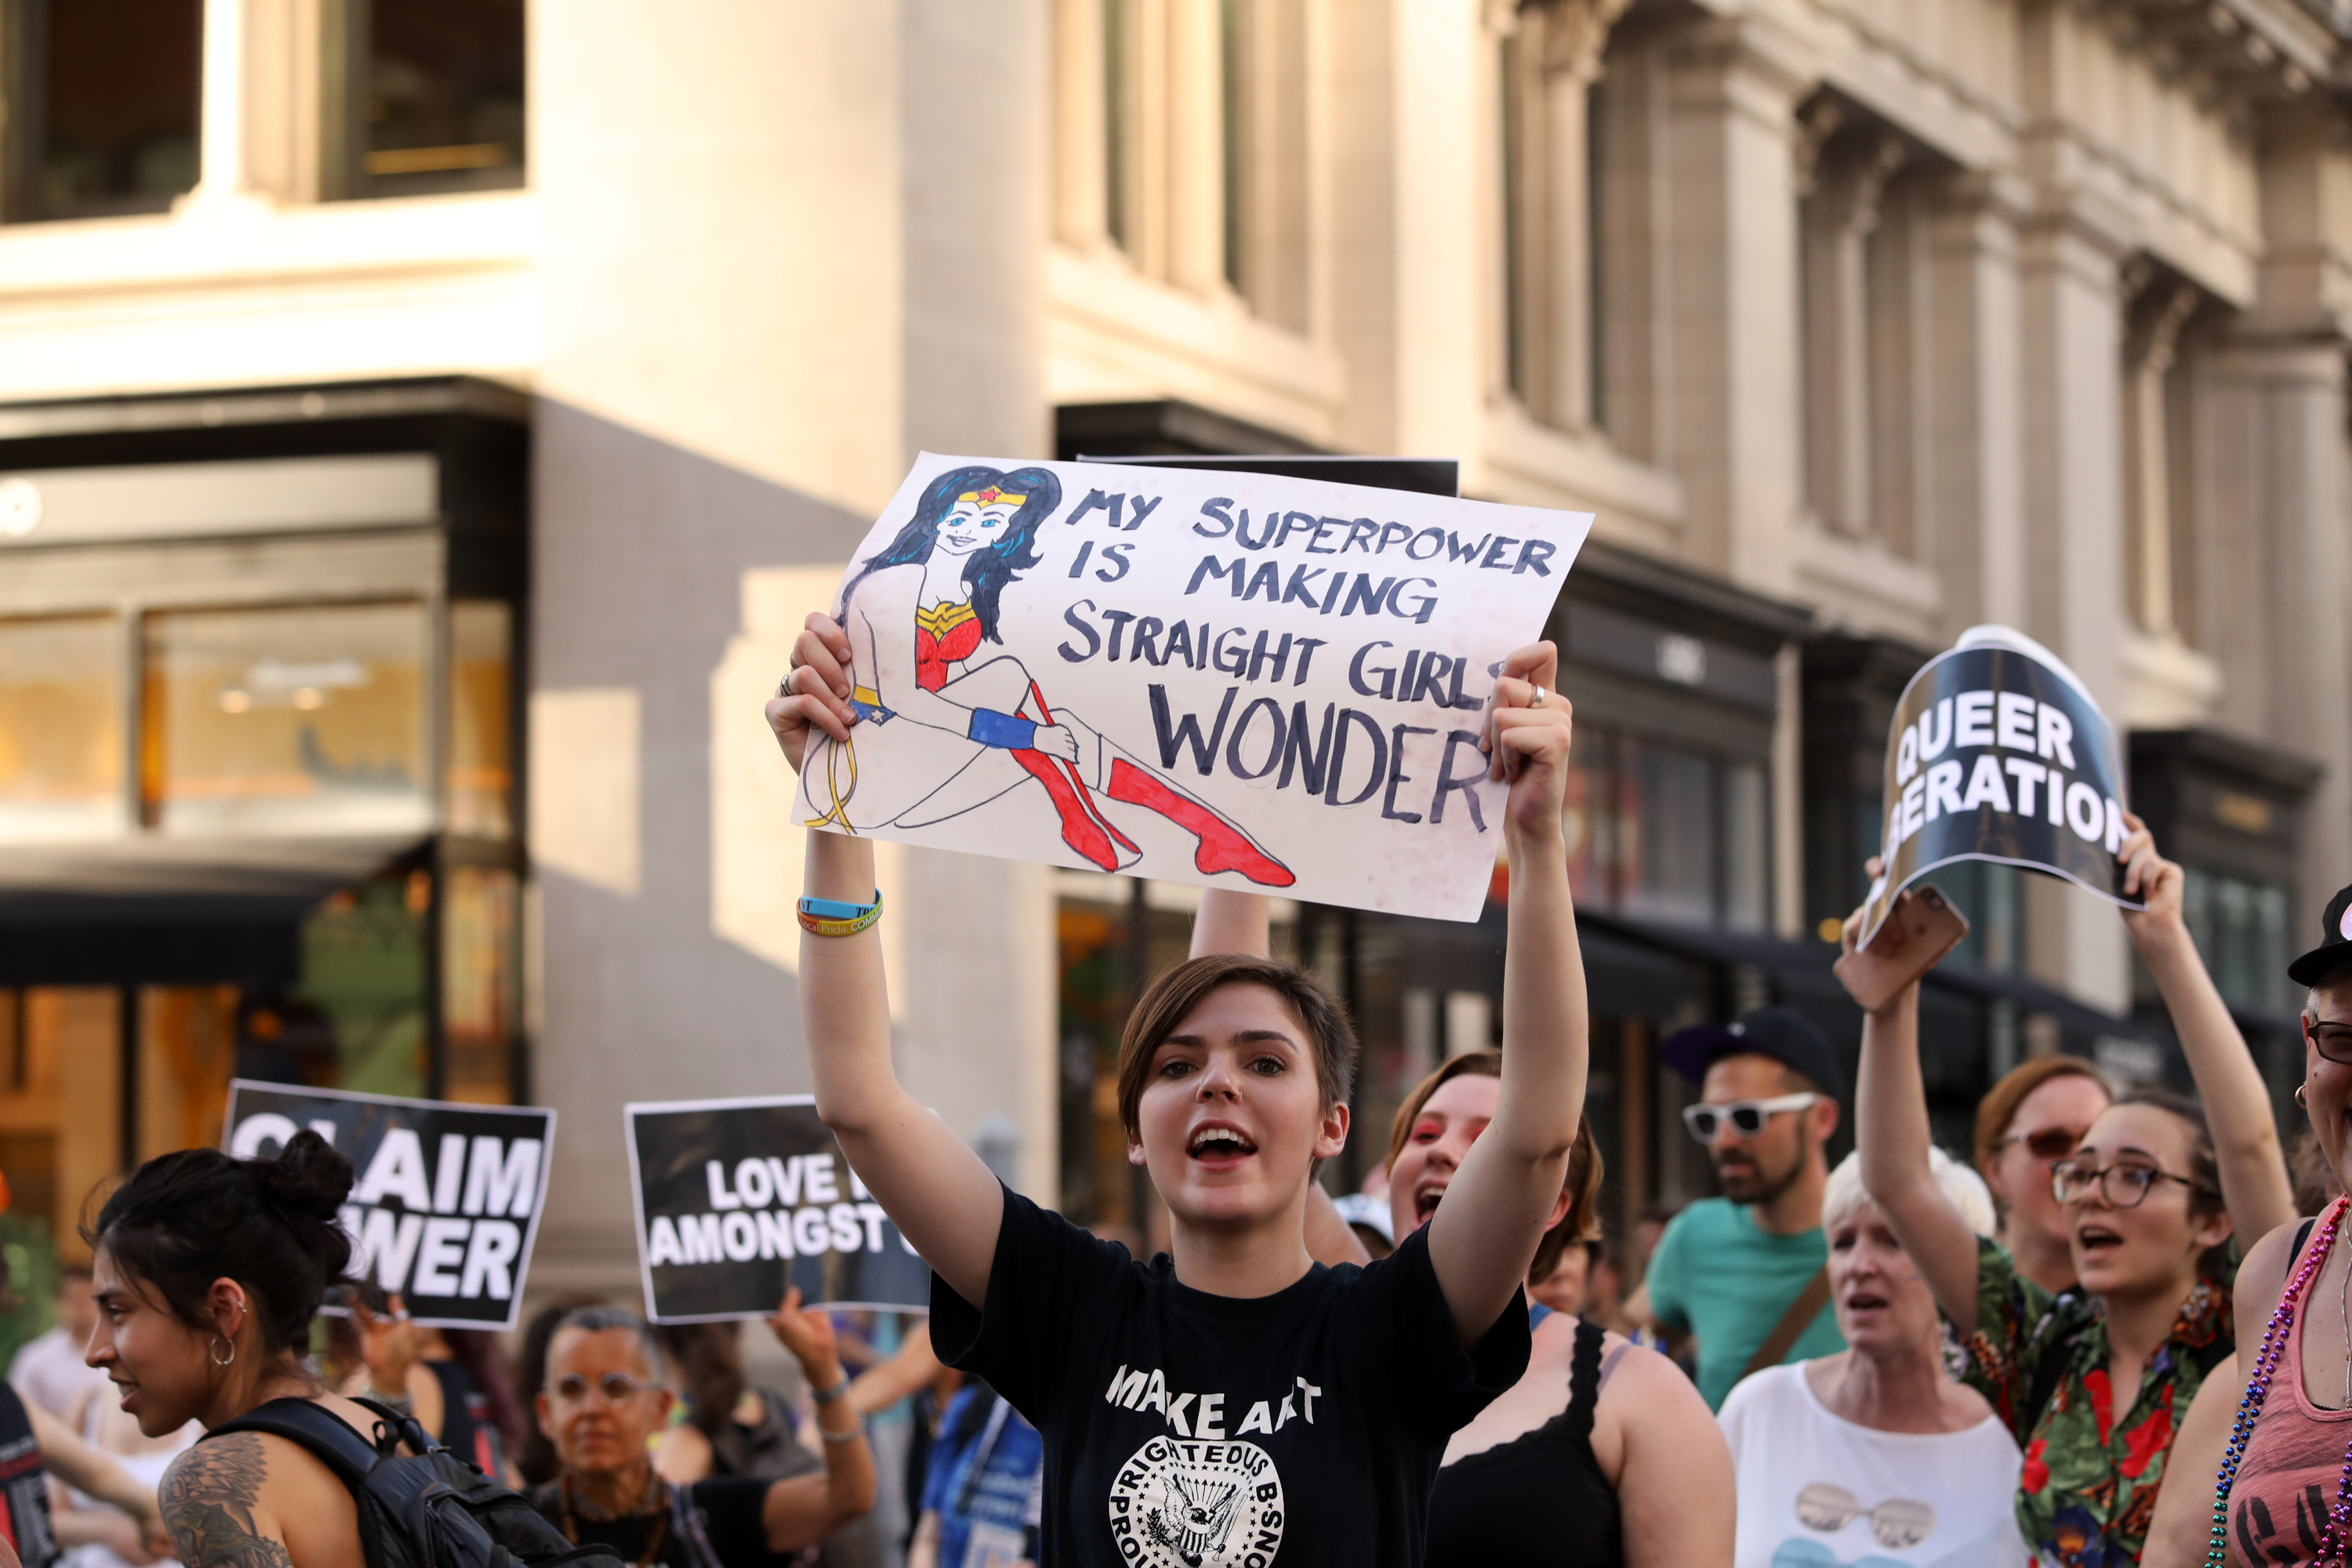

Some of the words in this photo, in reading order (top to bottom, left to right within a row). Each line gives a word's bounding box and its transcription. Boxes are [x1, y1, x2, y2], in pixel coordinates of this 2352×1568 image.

[1065, 488, 1163, 531] MY
[1192, 497, 1556, 578] SUPERPOWER
[1068, 541, 1135, 583] IS
[1184, 555, 1438, 624] MAKING
[1058, 598, 1329, 687] STRAIGHT
[1348, 641, 1505, 712] GIRL
[1148, 684, 1490, 833] WONDER
[1896, 690, 2076, 787] QUEER
[800, 916, 819, 932] Local
[821, 924, 849, 935] Pride.
[230, 1112, 543, 1219] CAIM
[706, 1152, 839, 1210] LOVE
[649, 1202, 887, 1267] AMONGST
[1105, 1363, 1225, 1440] MAKE
[1118, 1439, 1269, 1490] RIGHTEOUS
